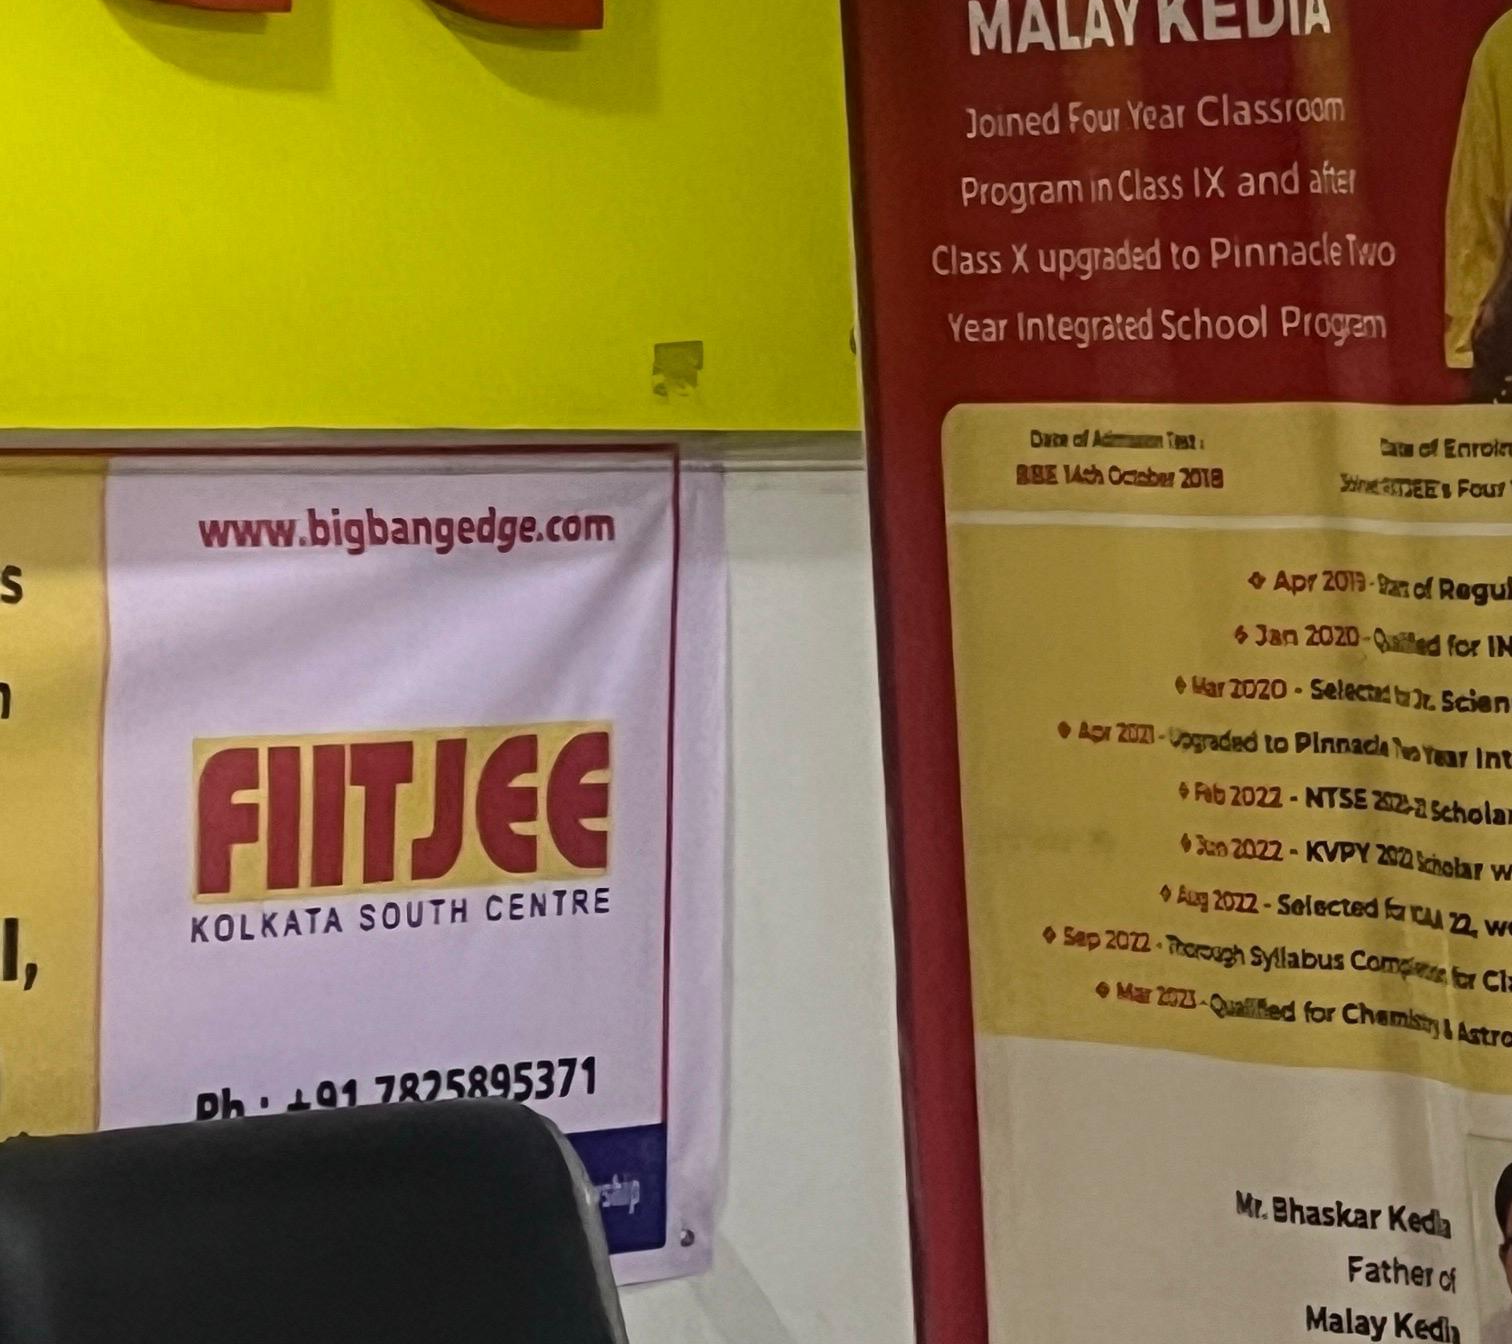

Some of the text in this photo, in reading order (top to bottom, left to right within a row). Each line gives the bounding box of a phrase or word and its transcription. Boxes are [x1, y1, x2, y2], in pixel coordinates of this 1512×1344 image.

[966, 94, 1344, 139] Joined Four Year Classroom
[962, 160, 1356, 214] Program in Class IX and after
[931, 231, 1396, 281] Class X upgraded to Pinnacle Two
[948, 305, 1387, 349] Year Integrated School Program
[199, 507, 616, 553] www.bigbangedge.com
[1305, 625, 1359, 646] 2020
[1448, 636, 1481, 659] for
[1231, 678, 1287, 700] 2020
[198, 731, 610, 895] FIITJEE
[1230, 786, 1283, 807] 2022
[1305, 787, 1368, 810] NTSE
[1232, 839, 1283, 860] 2022
[1307, 841, 1370, 863] KVPY
[191, 888, 611, 944] KOLKATA SOUTH CENTRE
[1213, 892, 1259, 914] 2022
[1277, 894, 1379, 919] Selected
[1063, 926, 1101, 951] Sep
[1106, 930, 1151, 952] 2022
[1250, 946, 1345, 974] Syllabus
[1304, 1000, 1336, 1024] for
[1236, 1190, 1452, 1239] Mr. Bhaskar Kedia
[1348, 1256, 1457, 1293] Father of
[1306, 1305, 1388, 1342] Malay
